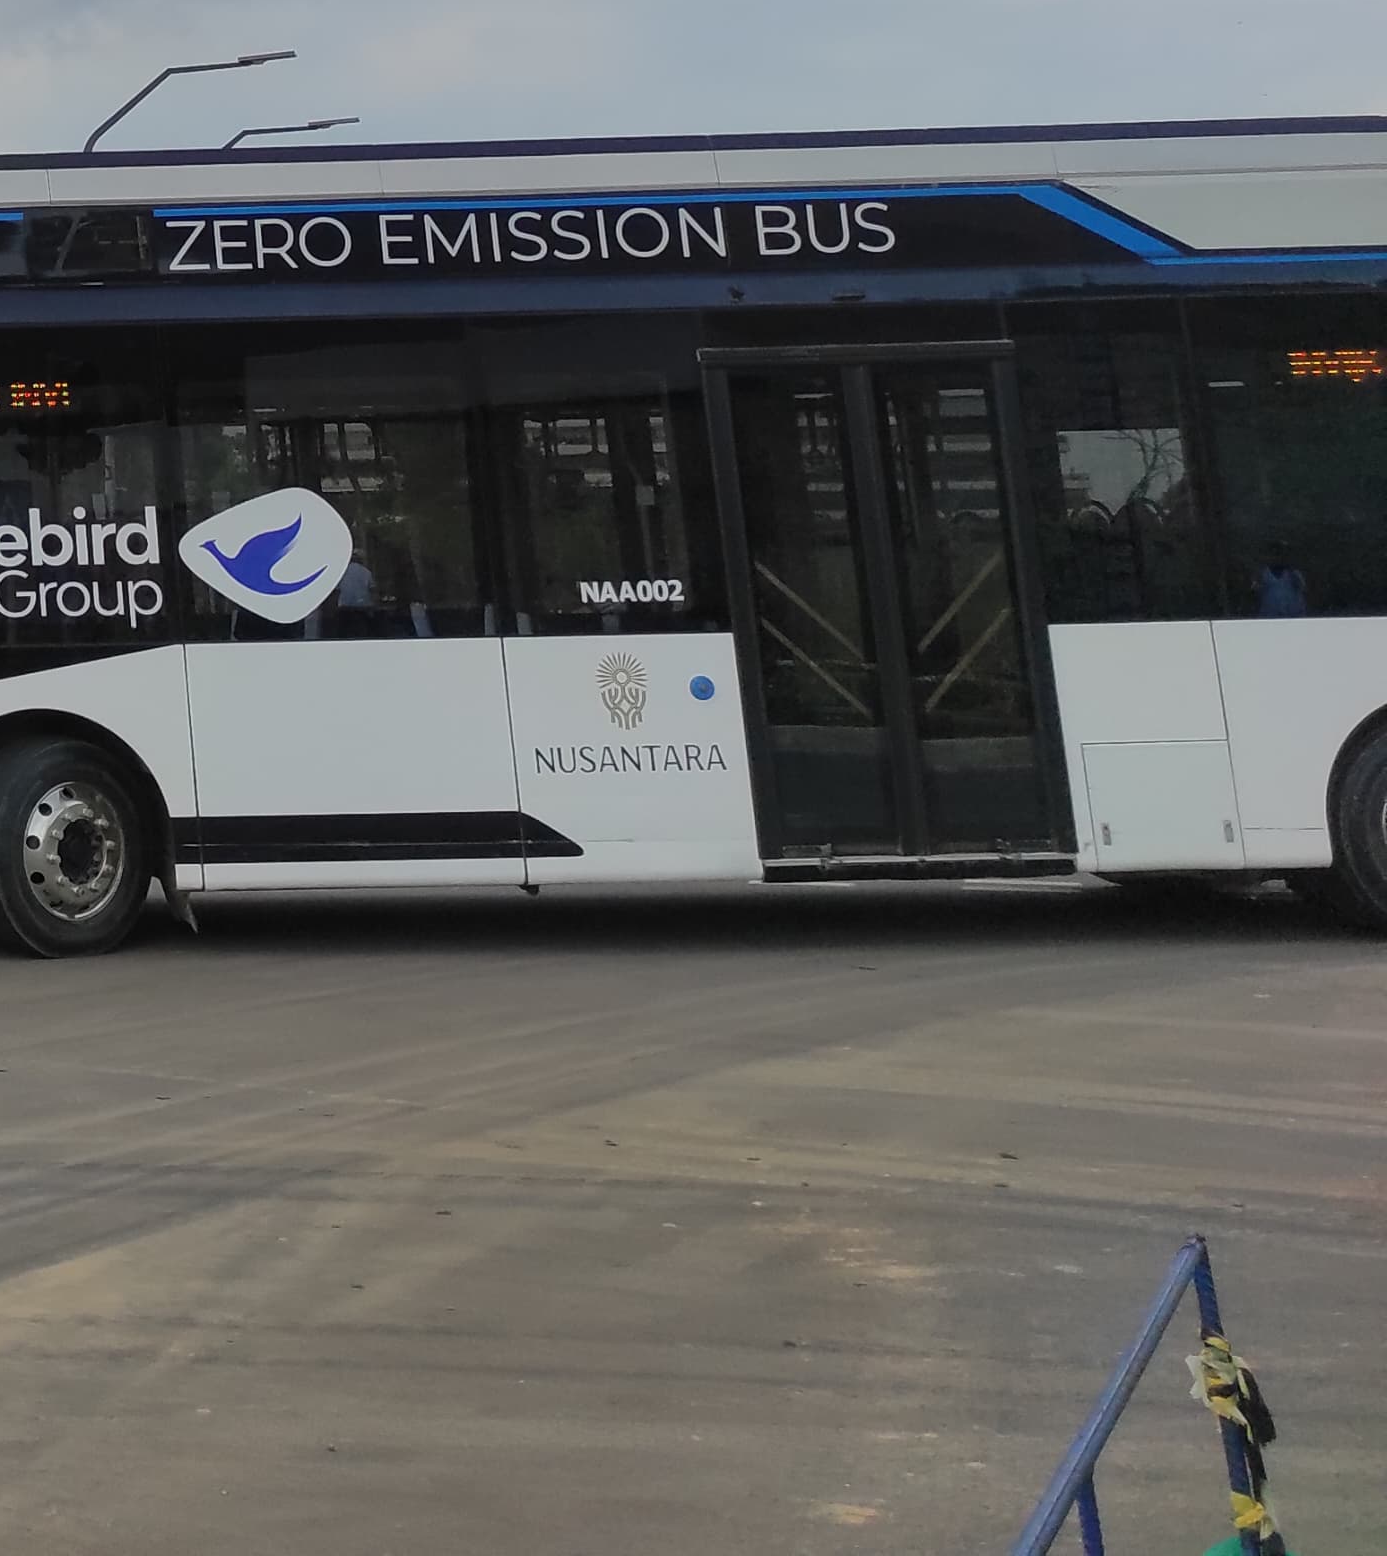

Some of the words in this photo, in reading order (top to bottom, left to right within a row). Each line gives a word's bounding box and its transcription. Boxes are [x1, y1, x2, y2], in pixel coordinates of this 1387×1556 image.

[165, 217, 352, 271] ZERO
[380, 206, 728, 265] EMISSION
[754, 202, 896, 257] BUS
[579, 579, 685, 604] NAA002
[534, 743, 727, 775] NUSANTARA
